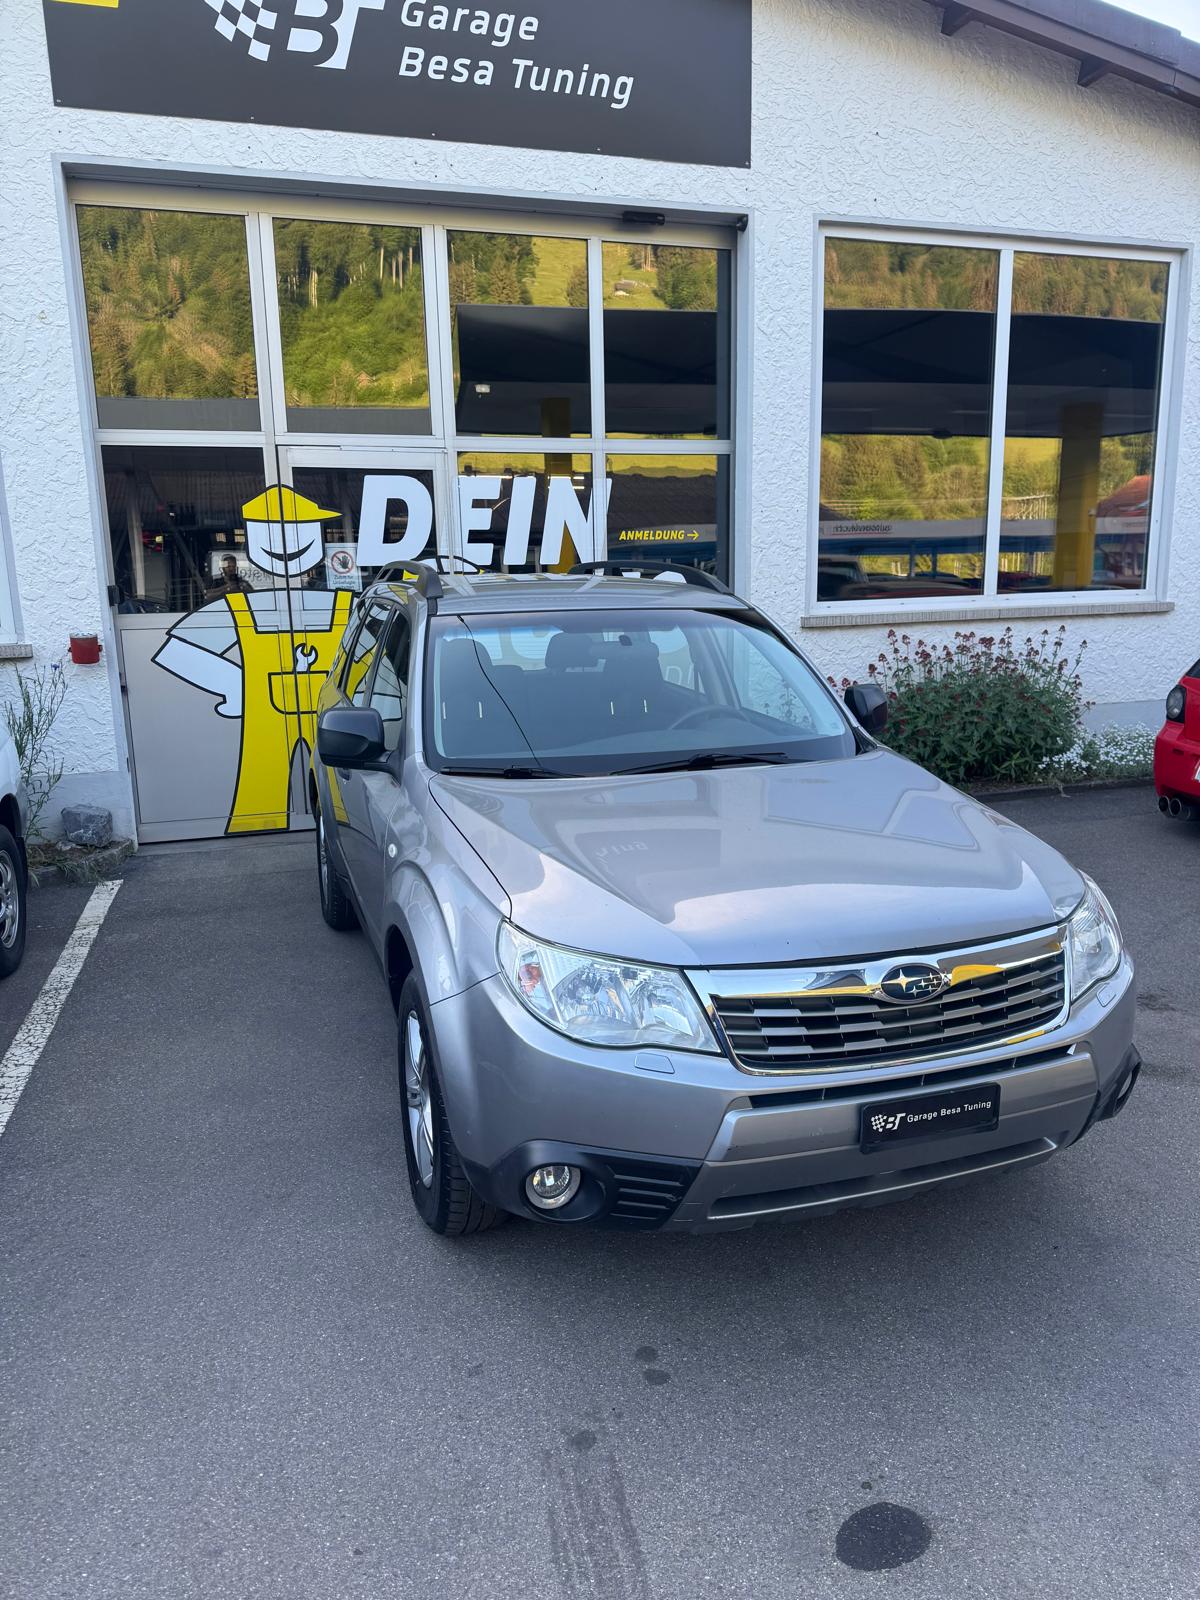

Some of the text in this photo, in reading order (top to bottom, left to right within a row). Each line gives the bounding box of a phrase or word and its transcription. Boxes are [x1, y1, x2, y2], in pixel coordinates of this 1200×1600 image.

[400, 0, 539, 47] Garage
[399, 46, 634, 109] Besa Tuning
[356, 475, 612, 566] DEIN
[619, 530, 685, 541] ANMELDUNG
[907, 1111, 938, 1123] Garage
[940, 1106, 961, 1117] Besa
[964, 1101, 992, 1112] Tuning
